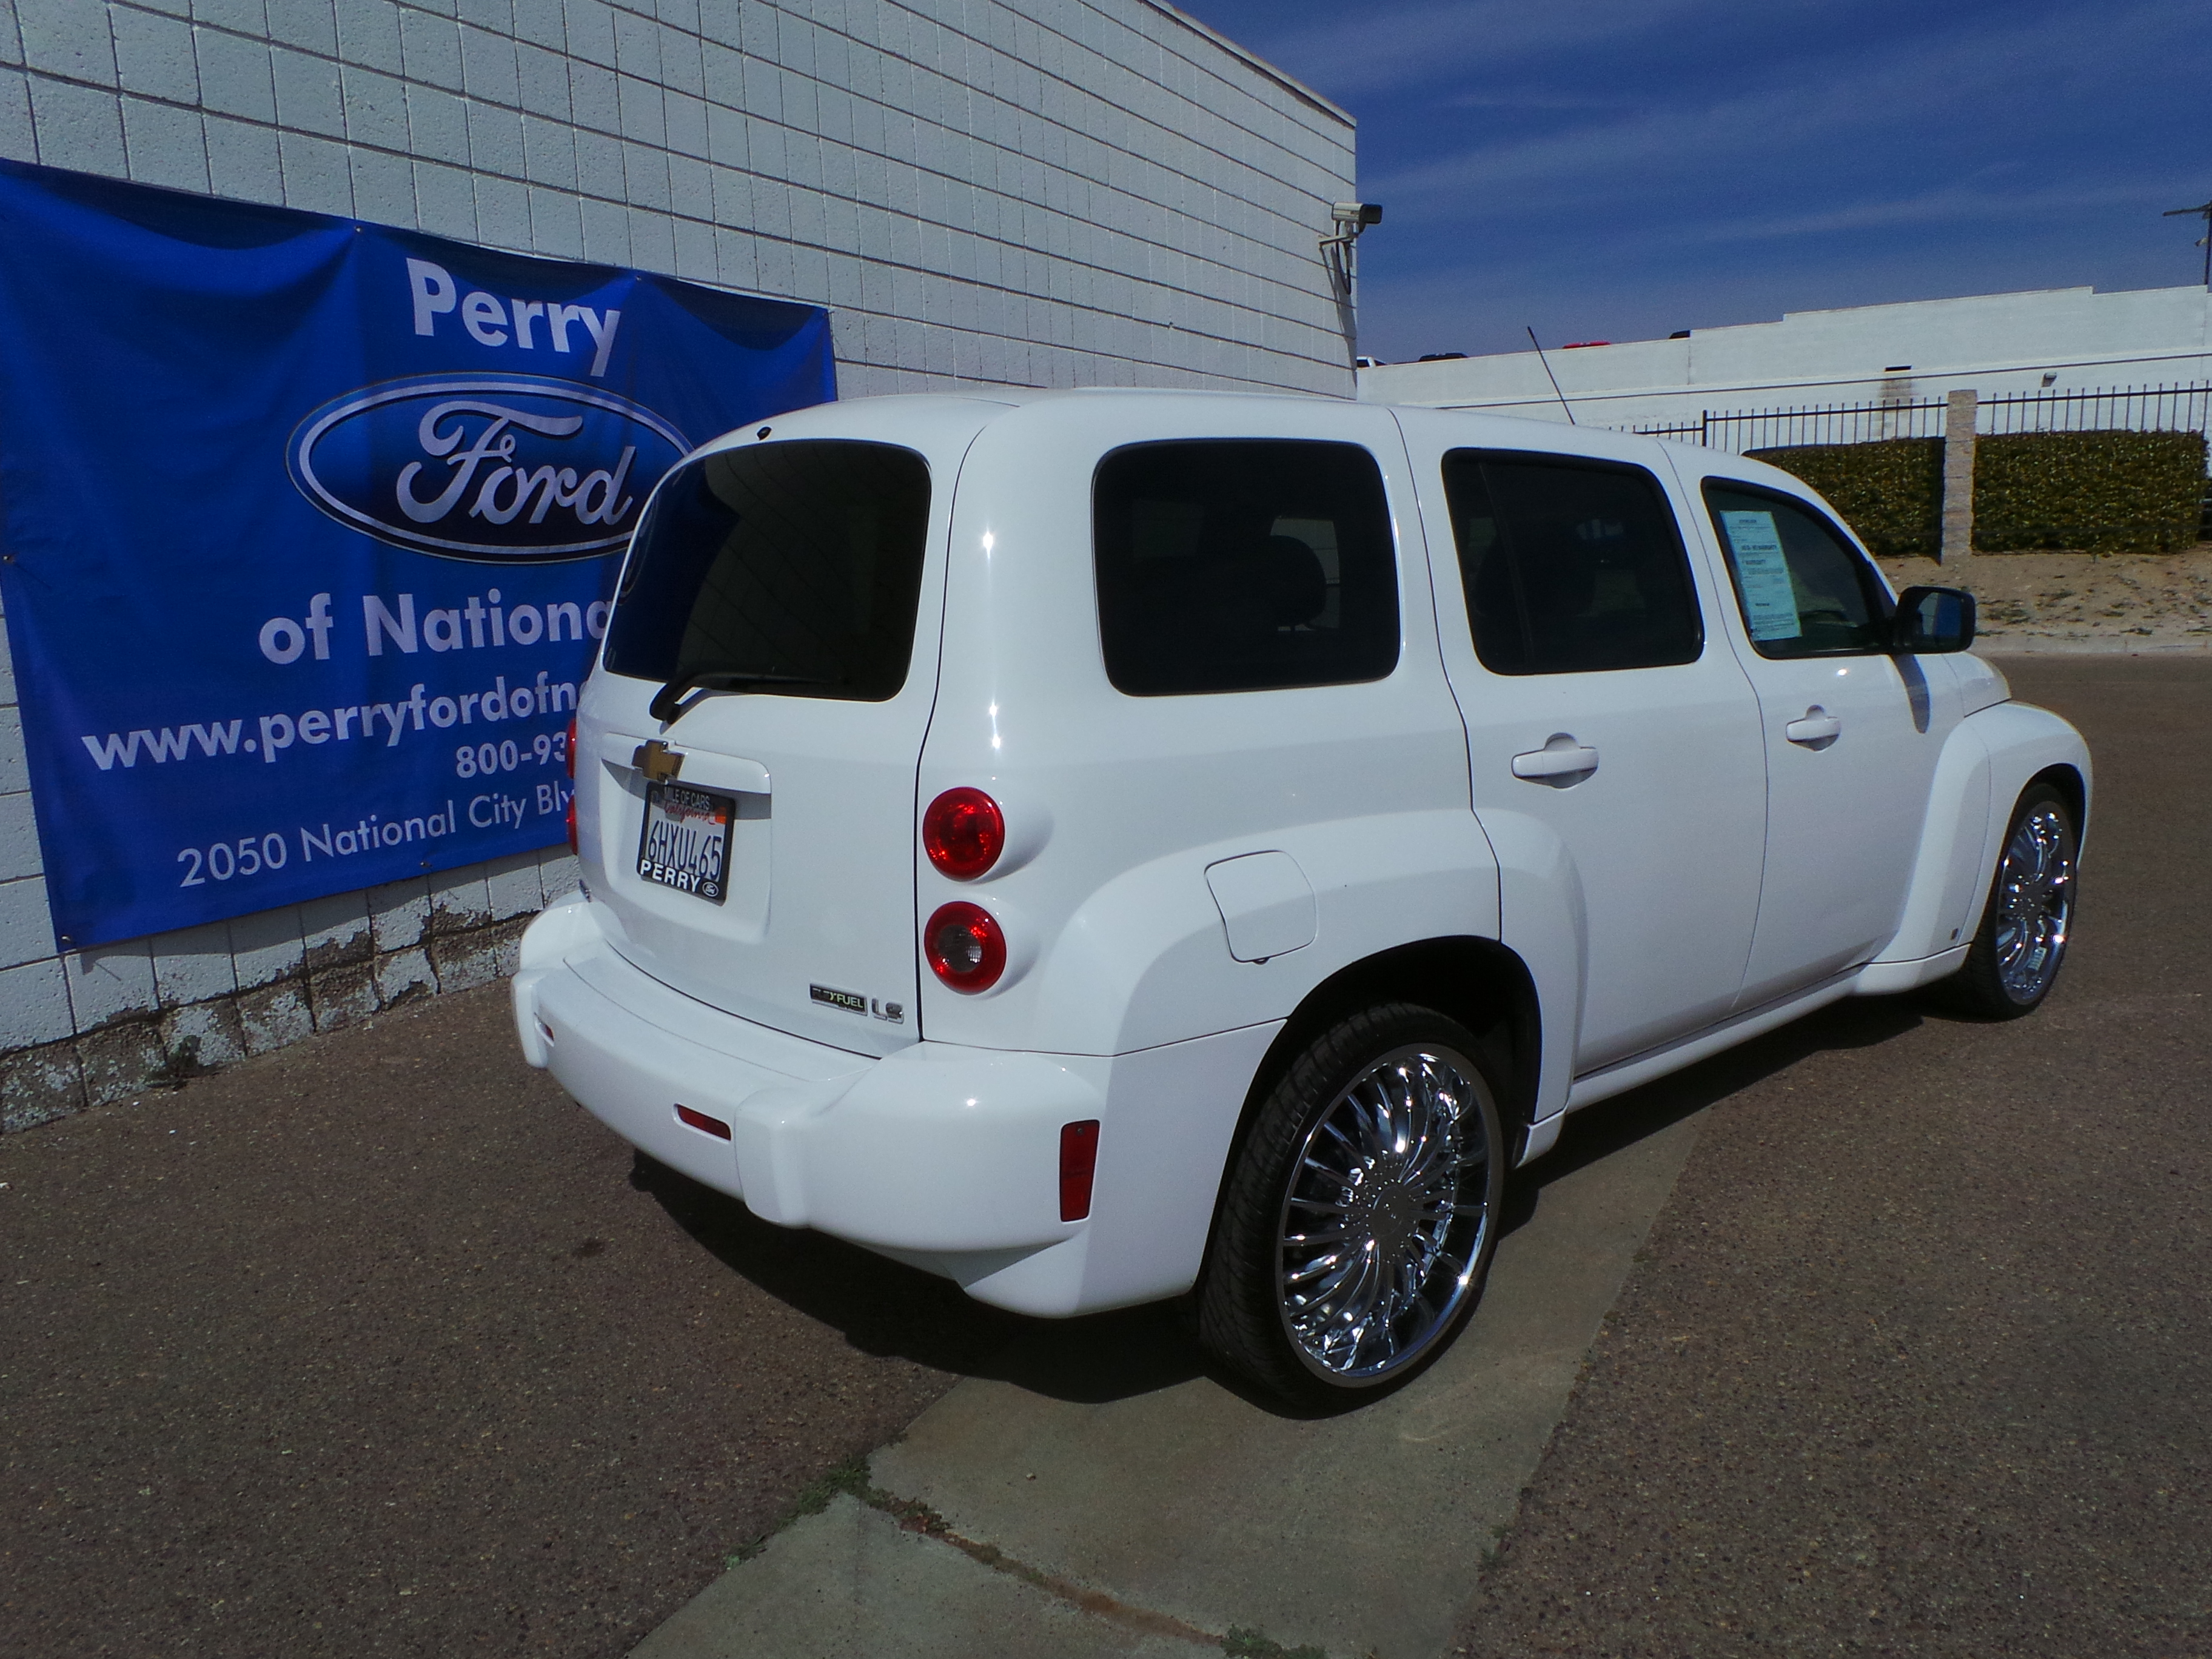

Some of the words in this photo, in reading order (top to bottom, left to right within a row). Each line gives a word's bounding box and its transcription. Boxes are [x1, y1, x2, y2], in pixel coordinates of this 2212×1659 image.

[406, 258, 621, 377] Perry
[397, 400, 636, 526] Ford
[258, 592, 333, 665] of
[680, 790, 690, 805] OF
[691, 792, 710, 811] CARS
[178, 833, 287, 887] 2050
[301, 800, 456, 862] National
[469, 793, 526, 829] City
[640, 859, 701, 893] PERRY
[648, 820, 722, 879] 6HXU465
